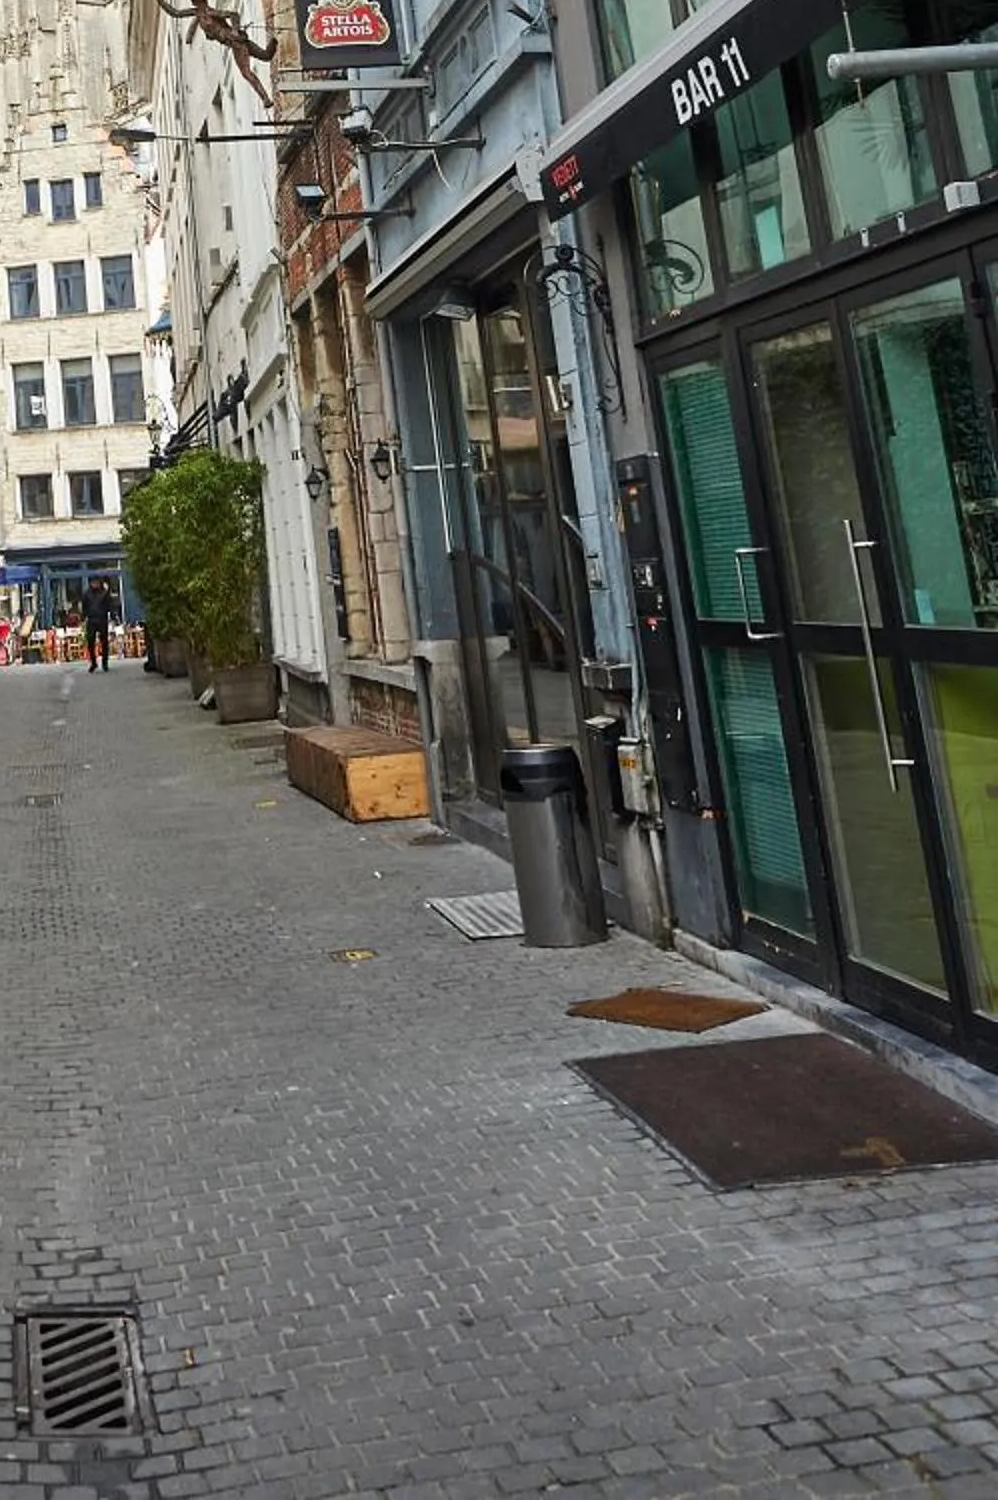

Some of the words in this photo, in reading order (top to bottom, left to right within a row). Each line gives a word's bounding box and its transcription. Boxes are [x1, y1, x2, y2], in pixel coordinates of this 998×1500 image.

[321, 13, 372, 28] STELLA
[322, 25, 374, 38] ARTOIS
[671, 55, 725, 126] BAR
[720, 36, 751, 88] 11
